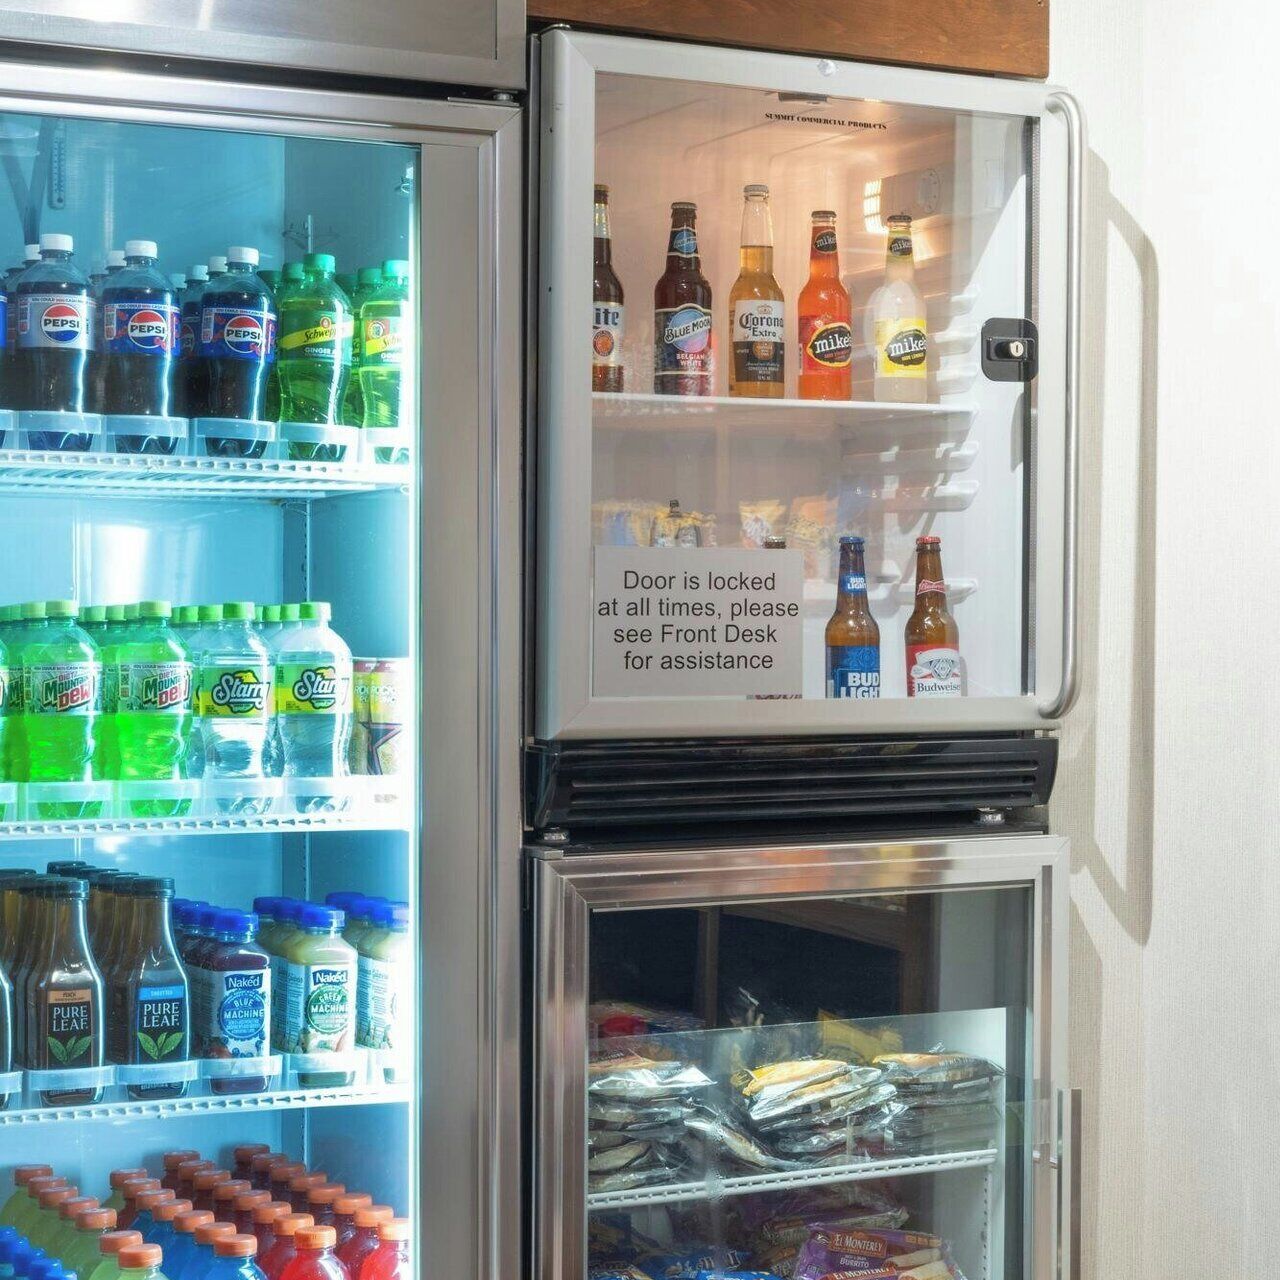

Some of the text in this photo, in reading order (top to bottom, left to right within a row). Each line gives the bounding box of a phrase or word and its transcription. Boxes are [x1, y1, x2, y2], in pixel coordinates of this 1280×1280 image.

[764, 113, 887, 130] SUMMIT COMMERCIAL PRODUCTS
[44, 318, 80, 328] PEPSI
[594, 307, 619, 326] ite
[130, 323, 166, 334] PEPSI
[226, 328, 261, 339] PEPSI
[665, 325, 691, 342] BLUE
[752, 327, 777, 338] Extra
[624, 570, 776, 590] Door is locked
[597, 598, 799, 621] at all times, please
[613, 624, 777, 643] see Front Desk
[624, 651, 773, 669] for assistance
[847, 672, 880, 686] BUD
[840, 686, 880, 698] LIGH
[917, 682, 960, 693] Budweise
[228, 976, 260, 988] Naked
[316, 971, 347, 983] Naked
[144, 1002, 180, 1016] PURE
[234, 998, 255, 1007] BLUE
[53, 1006, 88, 1019] PURE
[224, 1009, 264, 1019] MACHINE
[53, 1018, 88, 1032] LEAF
[143, 1014, 180, 1028] LEAF
[845, 1236, 883, 1252] MONTEREY
[840, 1258, 870, 1268] BURRITO
